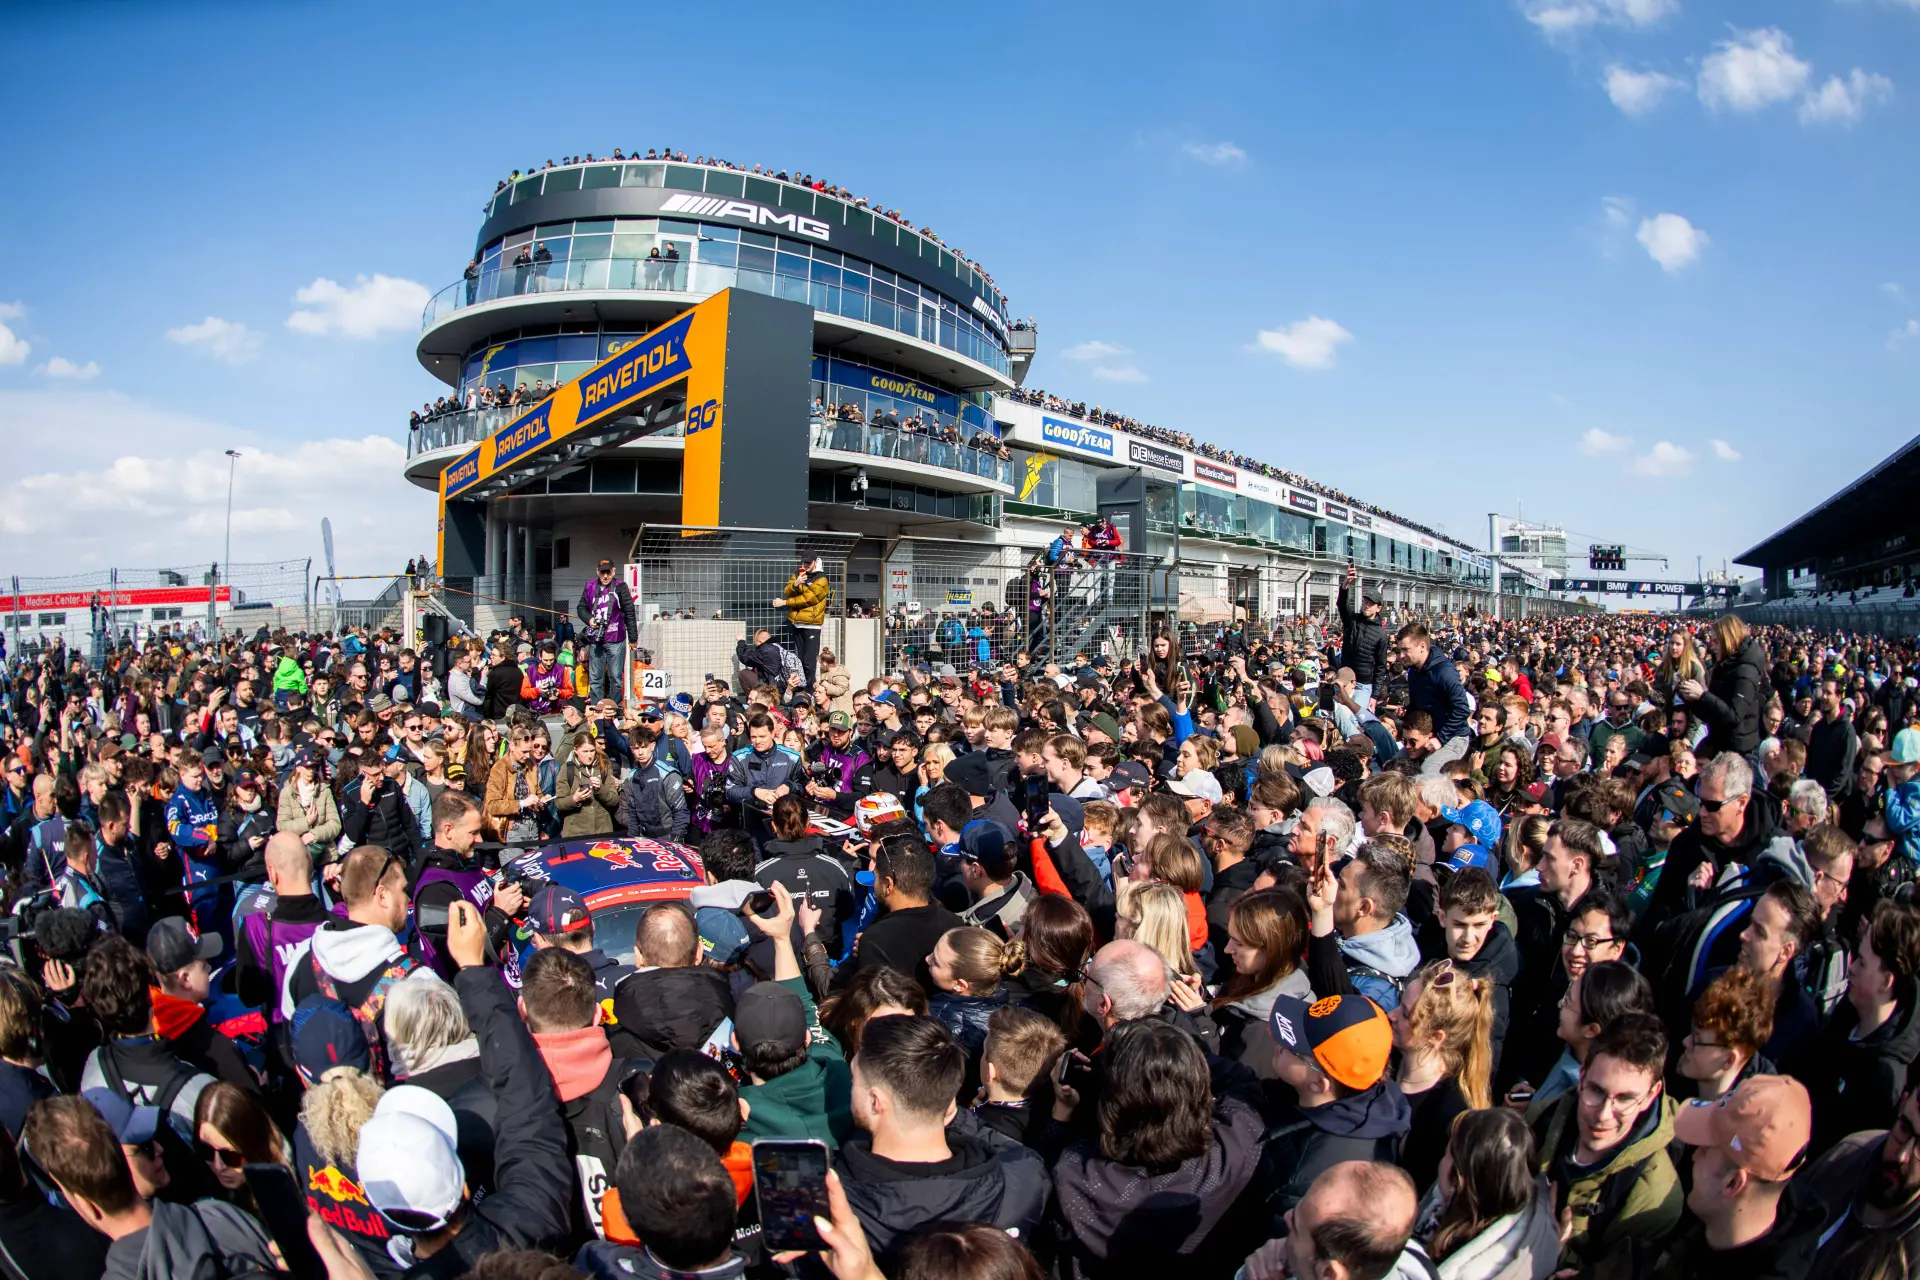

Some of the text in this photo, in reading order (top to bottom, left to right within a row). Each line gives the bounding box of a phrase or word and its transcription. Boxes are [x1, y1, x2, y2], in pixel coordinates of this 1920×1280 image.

[715, 200, 829, 241] AMG
[585, 340, 678, 408] RAVENOL
[687, 399, 716, 435] 80
[498, 415, 546, 458] RAVENOL
[447, 460, 477, 489] RAVENOL
[898, 497, 909, 508] 33
[1064, 512, 1072, 520] 31
[1606, 582, 1629, 591] BMW
[1655, 583, 1685, 593] POWER
[25, 594, 52, 607] Medical
[54, 596, 80, 605] Center
[644, 673, 663, 689] 2a
[307, 1195, 389, 1239] Red Bull
[736, 1223, 762, 1240] Moto
